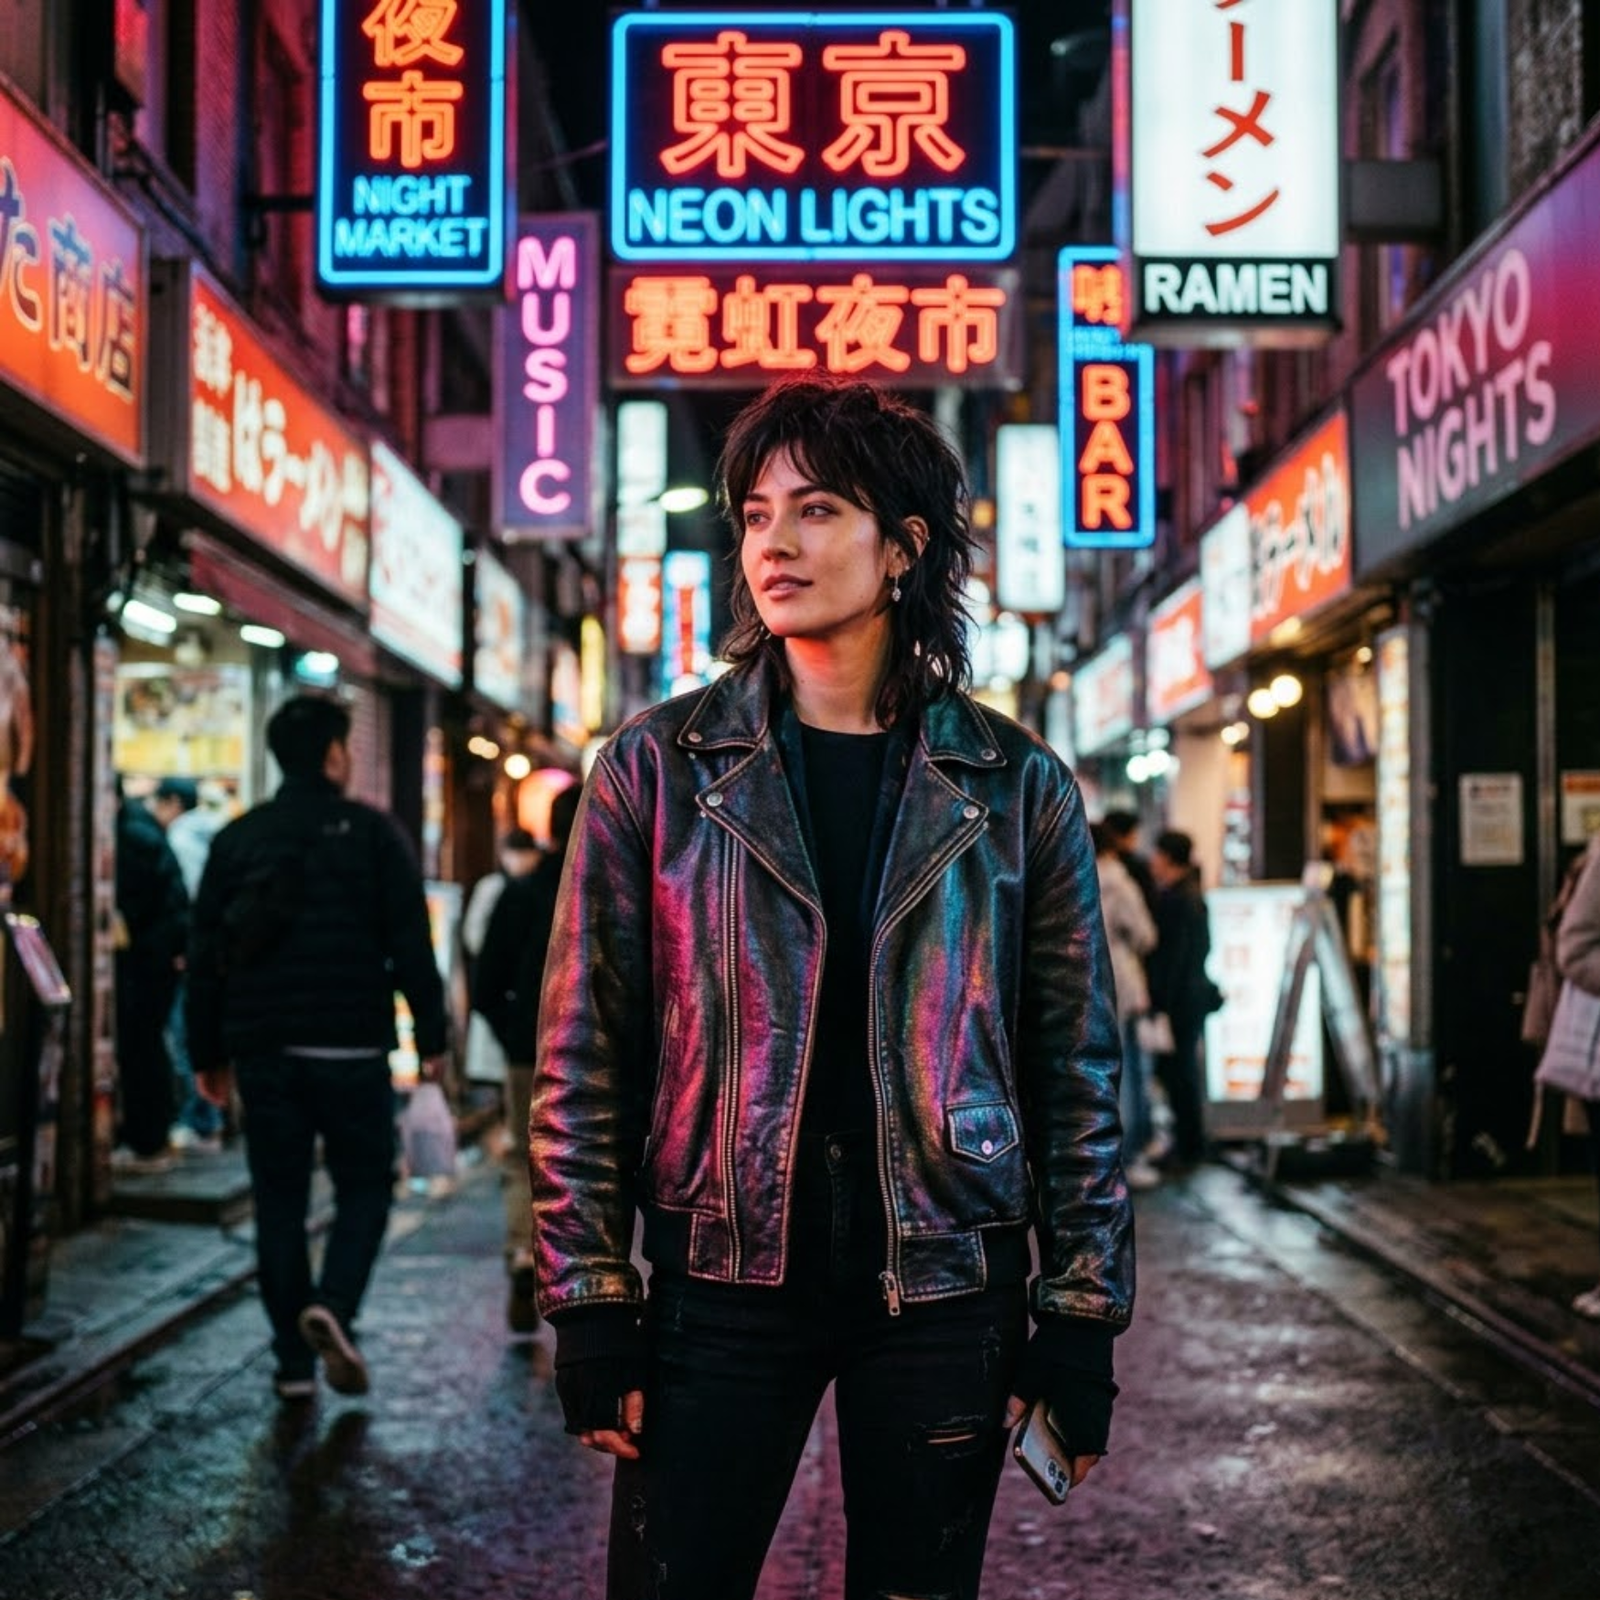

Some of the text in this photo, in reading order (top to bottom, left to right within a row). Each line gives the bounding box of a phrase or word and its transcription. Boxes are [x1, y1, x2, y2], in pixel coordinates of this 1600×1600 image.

[659, 30, 967, 178] 東京
[1200, 0, 1279, 236] ーメン
[334, 217, 488, 258] MARKET
[353, 174, 472, 216] NIGHT
[627, 187, 1001, 243] NEON LIGHTS
[624, 273, 1006, 374] 霓虹夜市
[1143, 262, 1329, 314] RAMEN
[1386, 249, 1531, 437] TOKYO
[516, 235, 577, 515] MUSIC
[1079, 364, 1134, 530] BAR
[1398, 340, 1557, 531] NIGHTS
